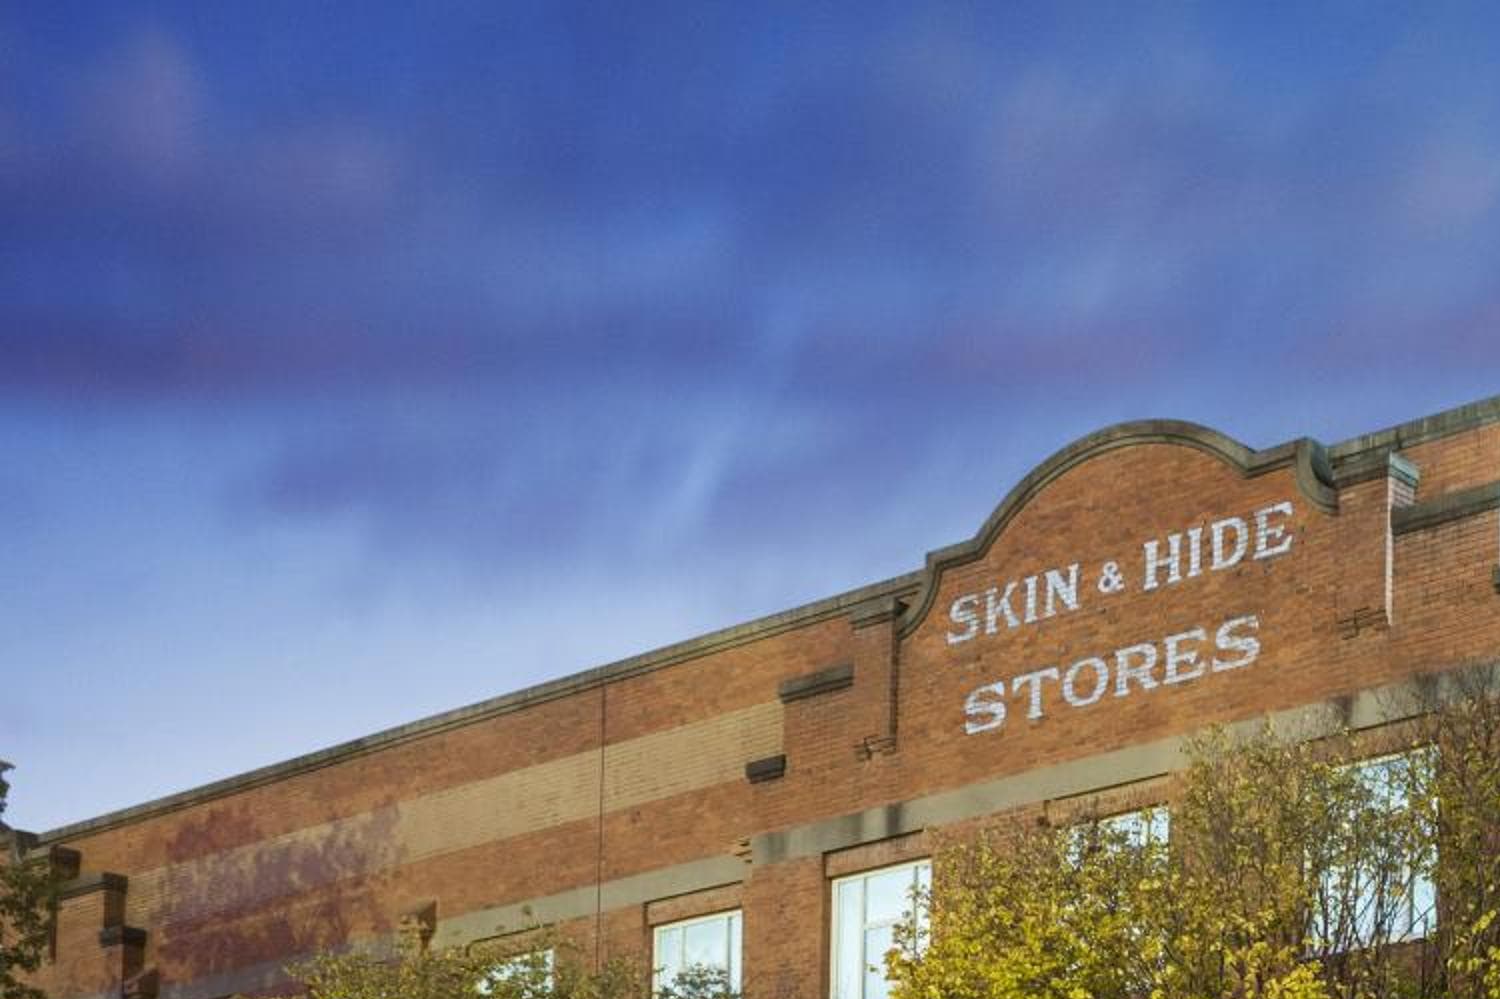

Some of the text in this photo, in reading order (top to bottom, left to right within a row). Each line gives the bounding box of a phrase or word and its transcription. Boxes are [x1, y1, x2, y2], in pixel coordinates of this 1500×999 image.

[947, 502, 1293, 645] SKIN & HIDE
[964, 615, 1262, 735] STORES
